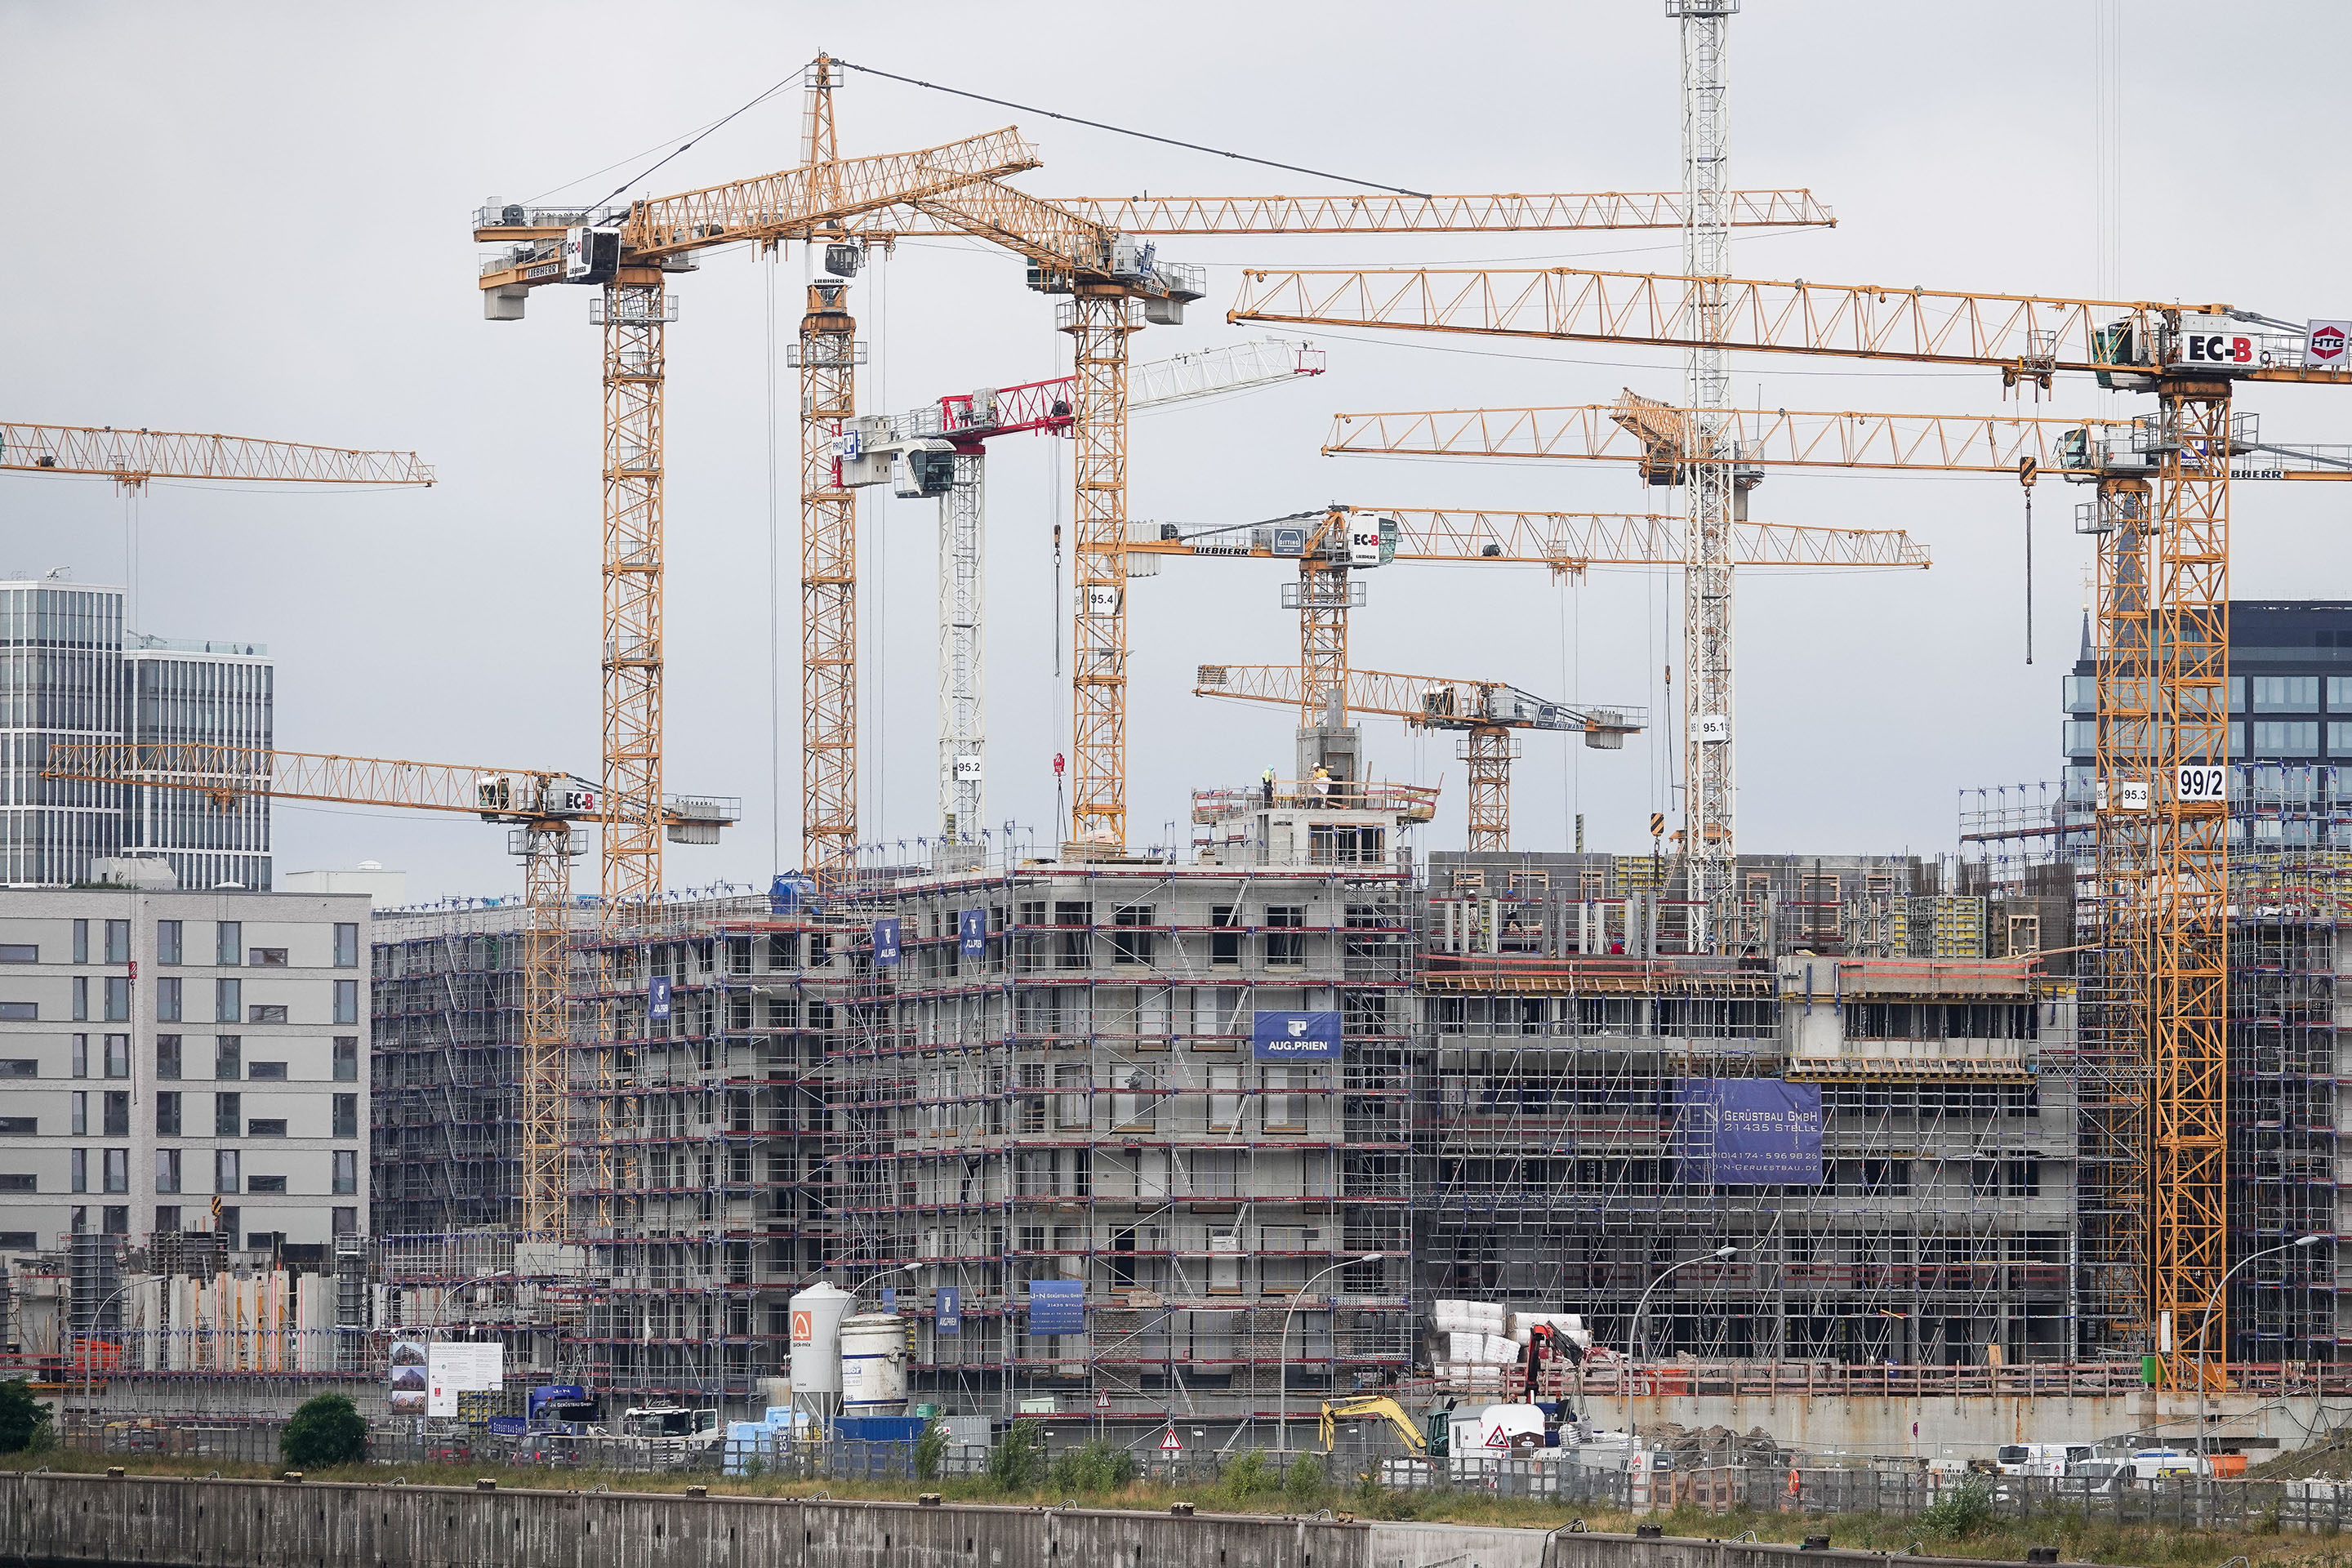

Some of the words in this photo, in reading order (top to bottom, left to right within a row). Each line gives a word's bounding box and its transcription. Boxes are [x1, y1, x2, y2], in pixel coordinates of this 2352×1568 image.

[528, 265, 557, 278] LIEBHERR
[2312, 338, 2344, 347] HTG
[2189, 336, 2252, 363] EC-B
[1354, 533, 1379, 546] EC-B
[1196, 546, 1250, 555] LIEBHERR
[1091, 595, 1113, 604] 95.4
[1704, 723, 1724, 733] 95.1
[959, 763, 980, 772] 95.2
[2180, 770, 2223, 795] 99/2
[2124, 790, 2147, 800] 95.3
[565, 792, 593, 809] EC-B
[1268, 1040, 1328, 1050] AUG.PRIEN
[1725, 1124, 1770, 1132] 21435
